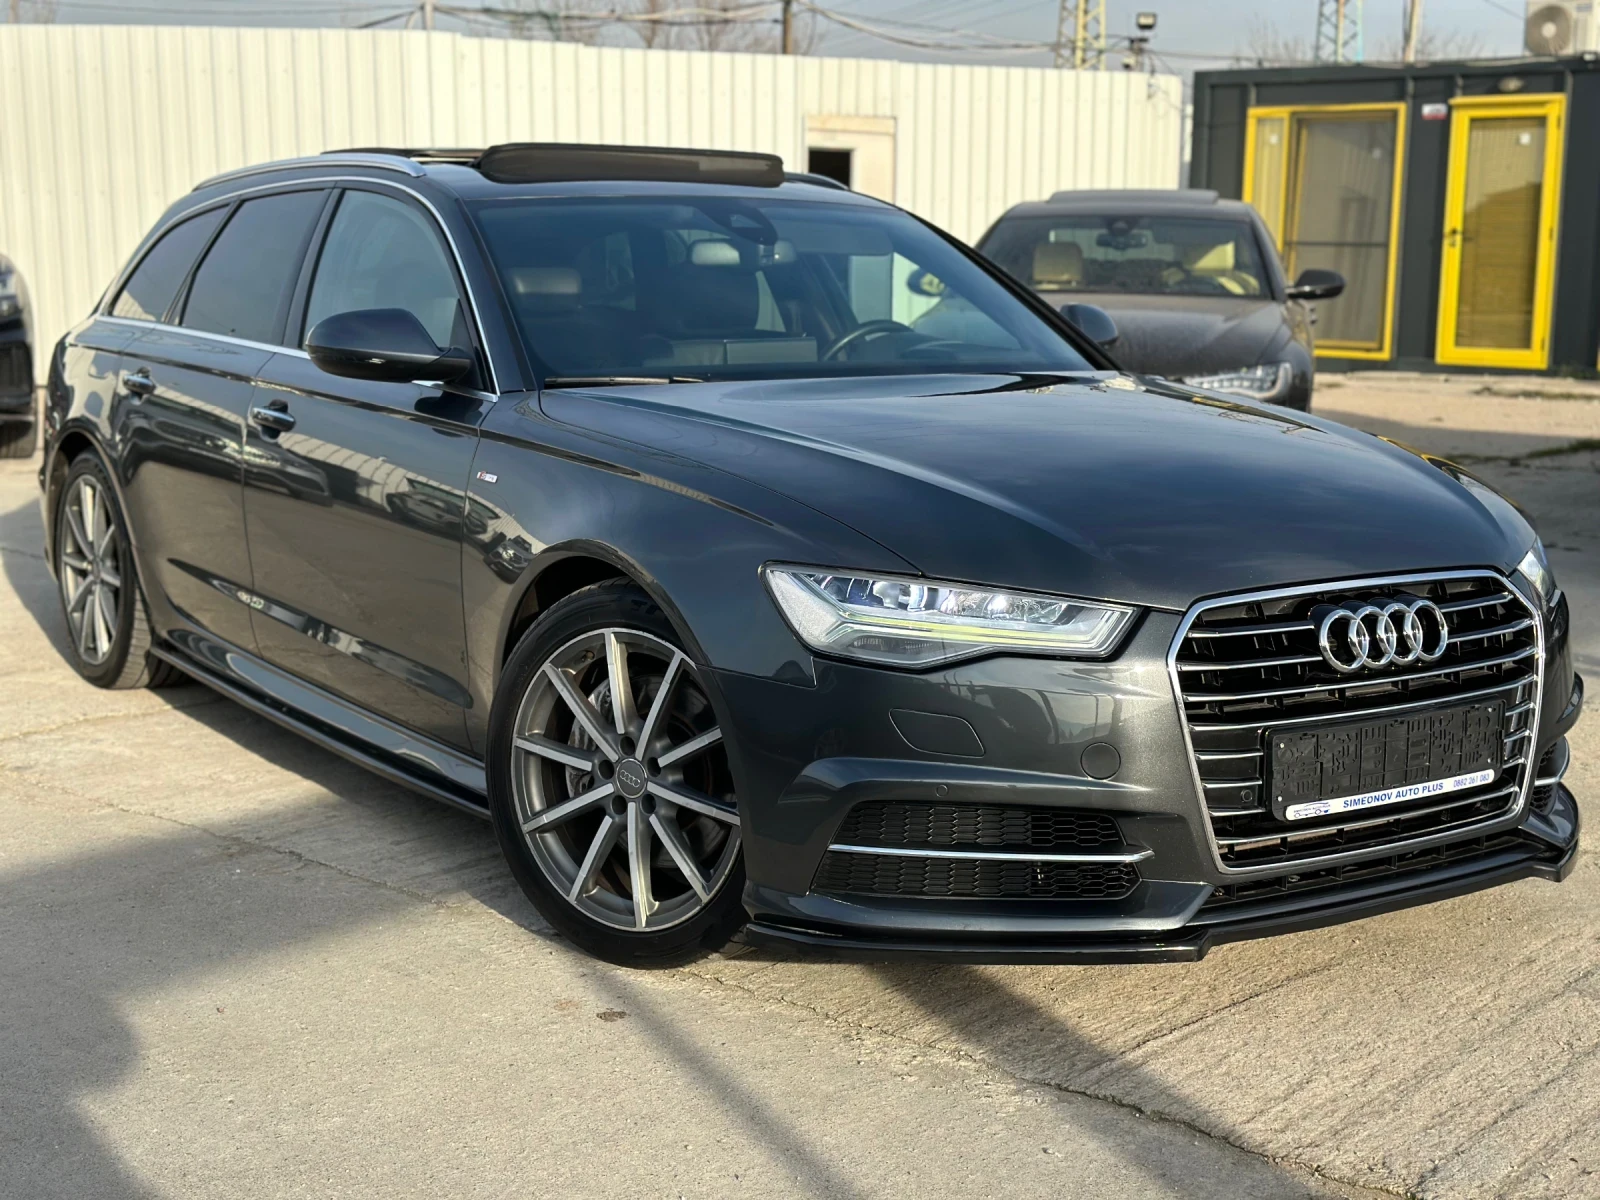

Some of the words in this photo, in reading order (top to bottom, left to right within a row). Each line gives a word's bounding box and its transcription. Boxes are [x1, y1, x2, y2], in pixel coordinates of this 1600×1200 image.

[1343, 792, 1393, 808] SIMEONOV
[1395, 786, 1420, 798] AUTO
[1422, 782, 1444, 793] PLUS
